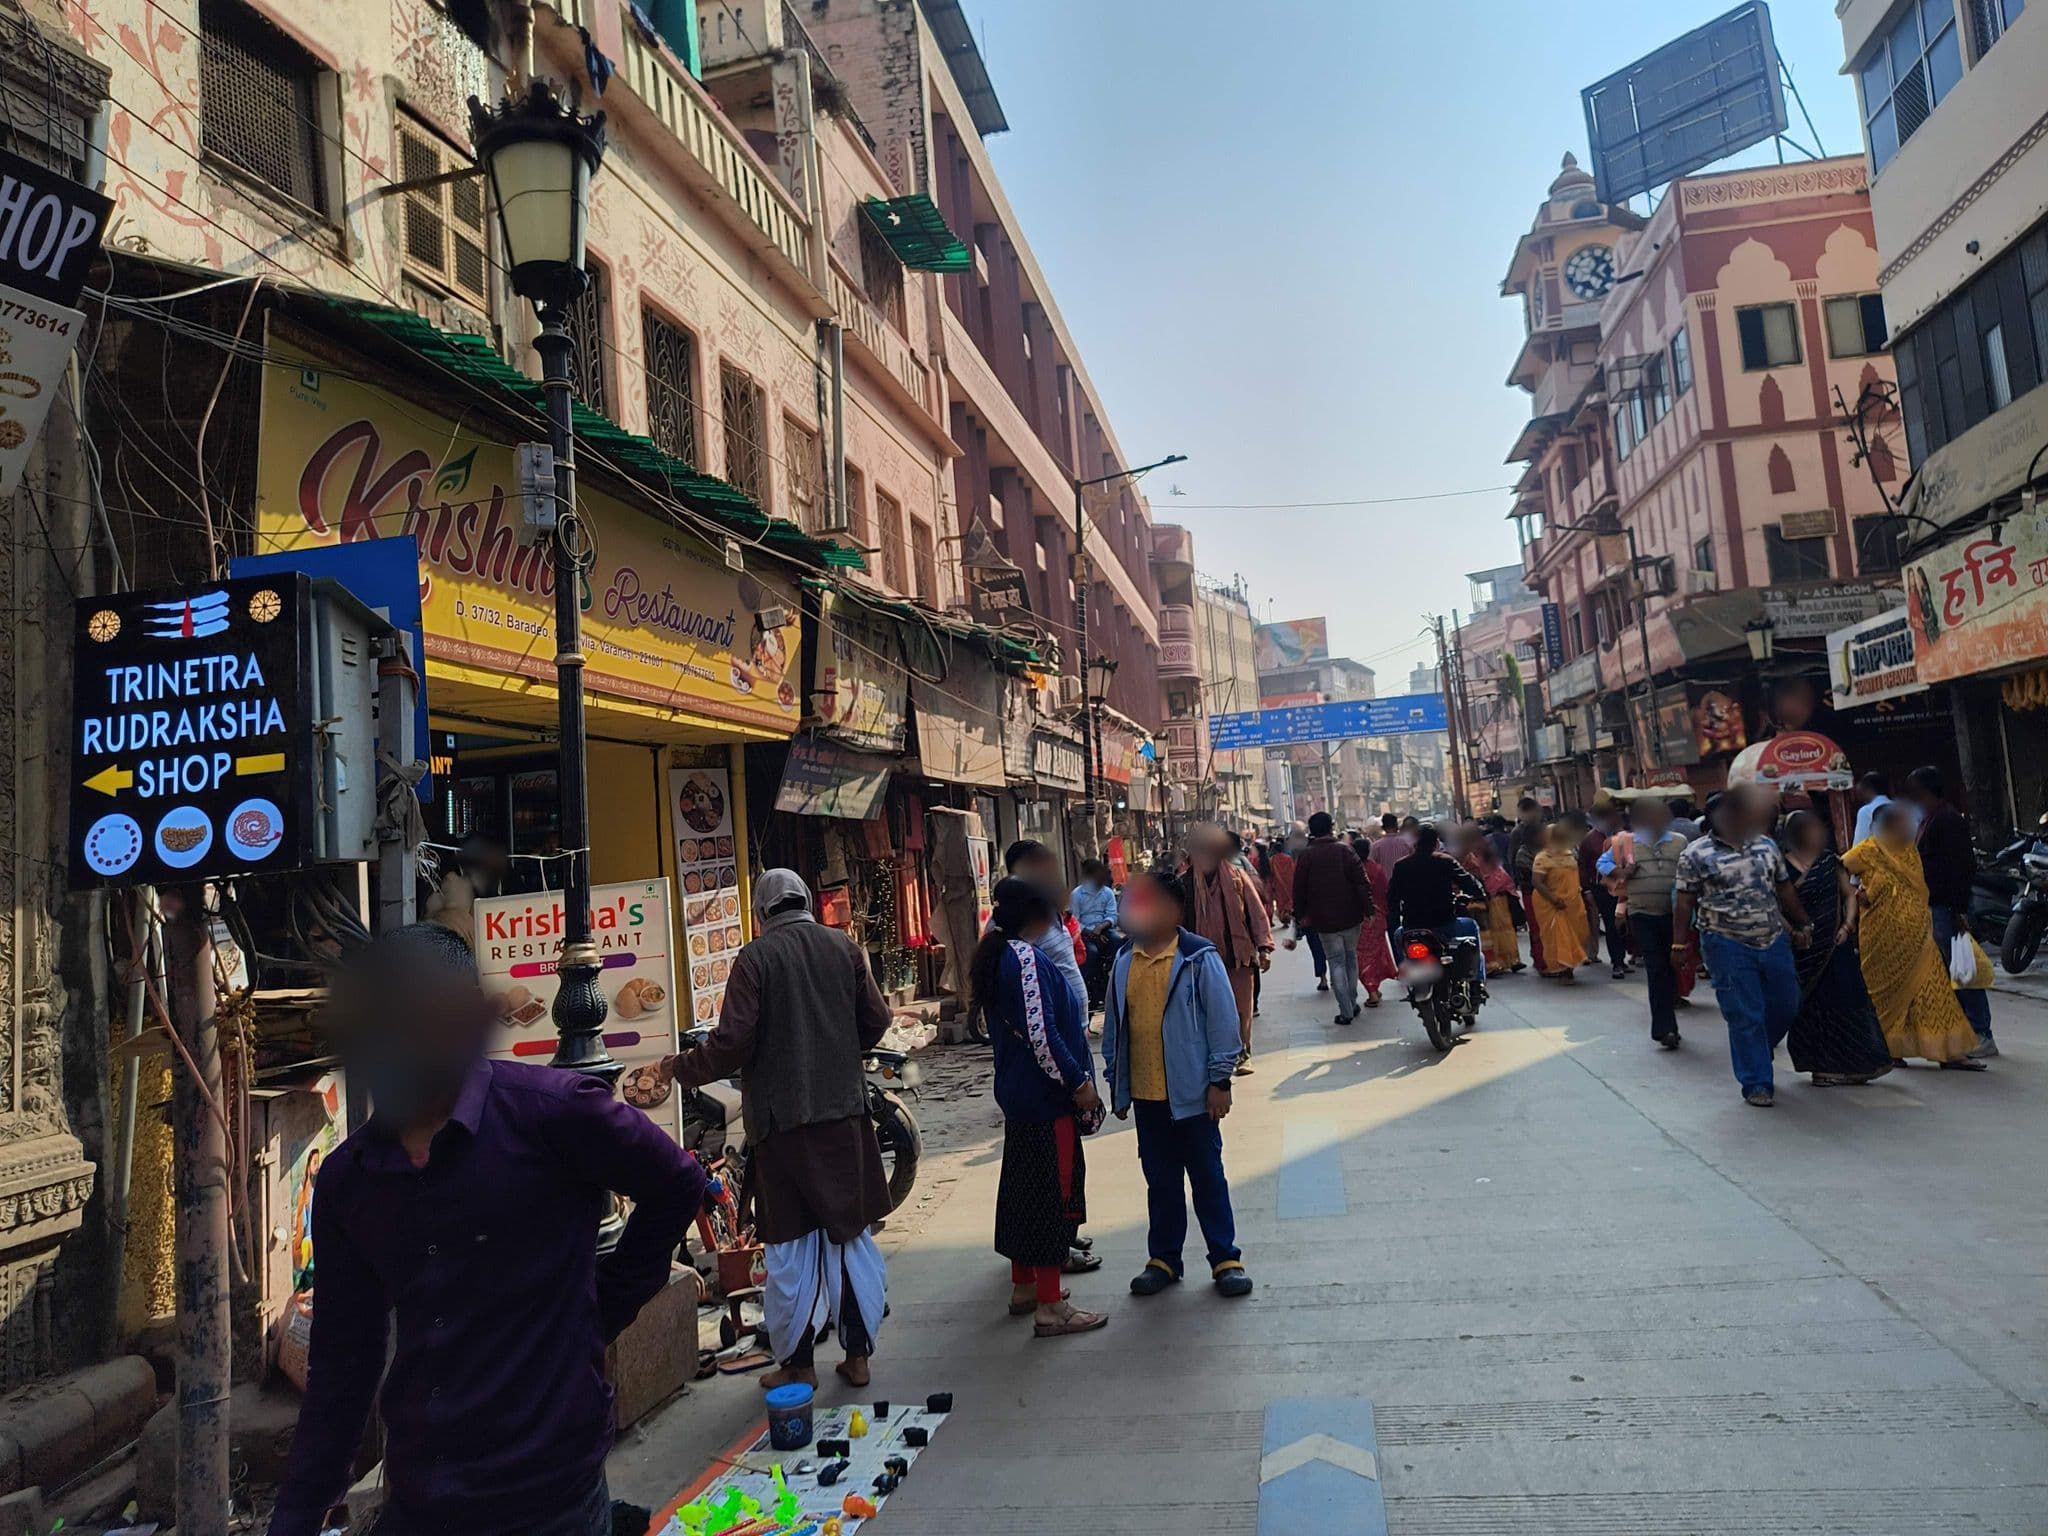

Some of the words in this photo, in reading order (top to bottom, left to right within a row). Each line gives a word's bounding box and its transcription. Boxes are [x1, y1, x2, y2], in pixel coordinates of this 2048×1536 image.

[0, 298, 70, 336] 773614
[604, 567, 737, 648] Restaurant
[1813, 587, 1831, 599] AC
[456, 601, 468, 617] D.
[472, 605, 503, 627] 37/32,
[506, 614, 551, 640] Baradeo,
[600, 640, 633, 660] Varanasi
[105, 651, 265, 704] TRINETRA
[83, 697, 287, 755] RUDRAKSHA
[1780, 748, 1820, 762] Gaylord
[137, 752, 231, 798] SHOP
[485, 896, 644, 941] Krisha's
[491, 932, 643, 960] RESTAANT
